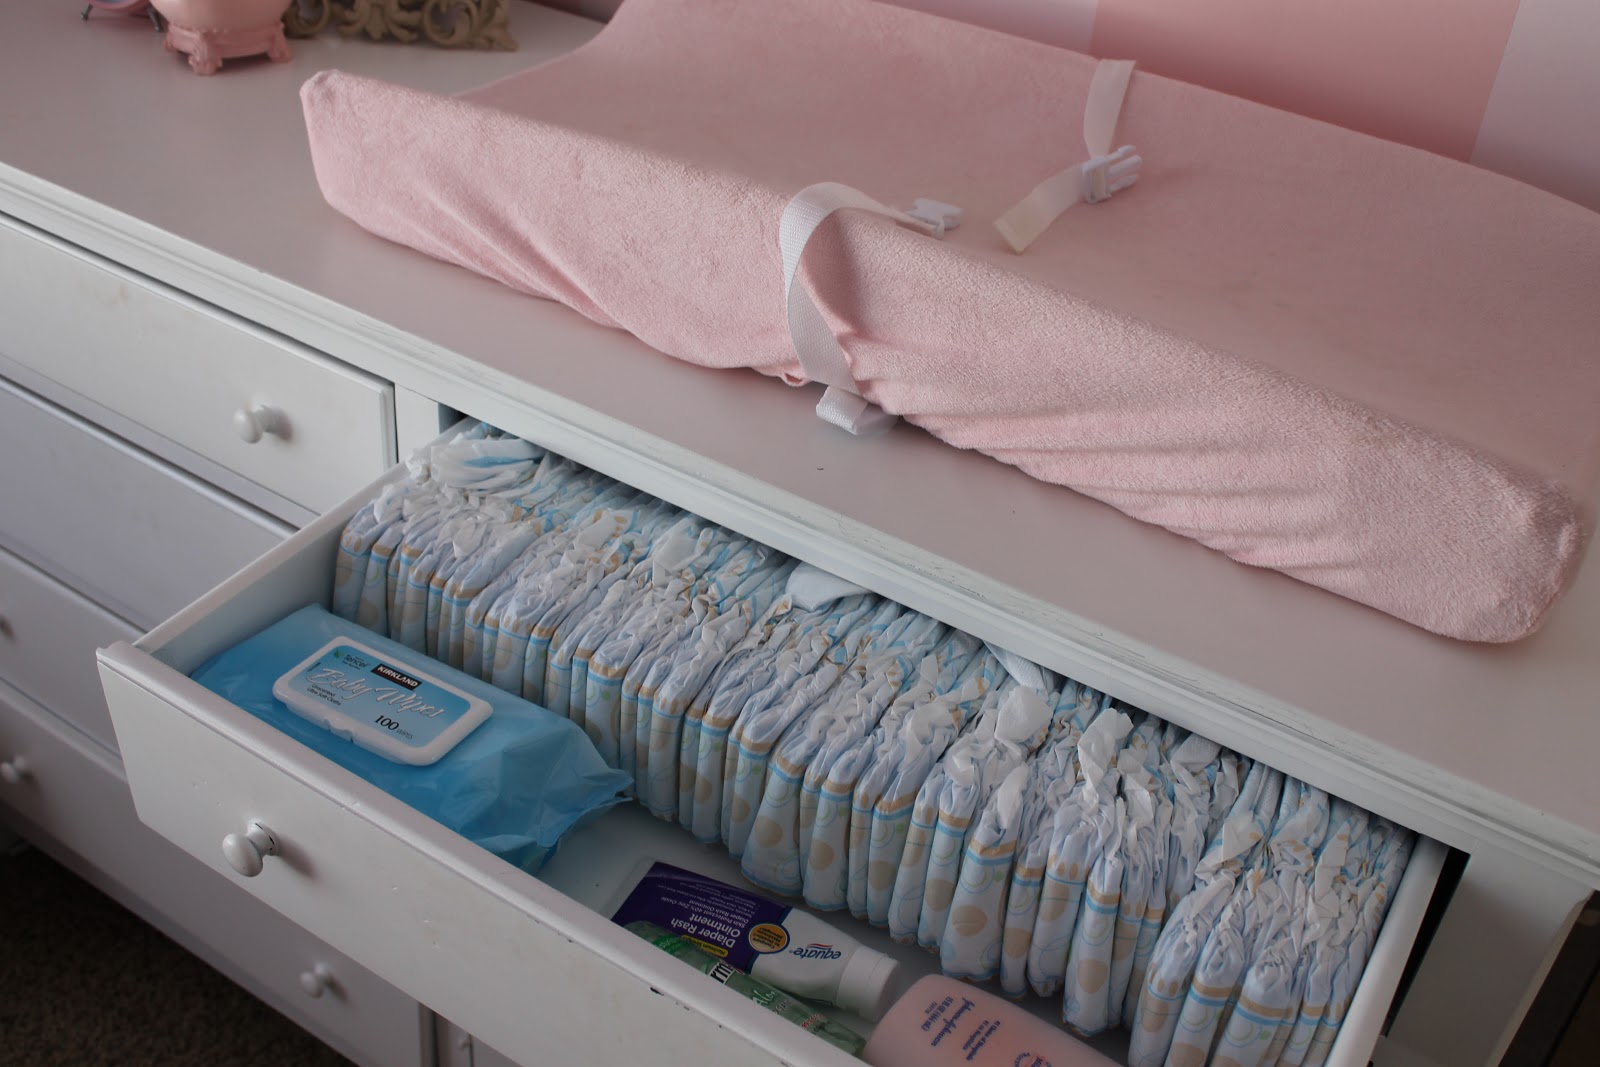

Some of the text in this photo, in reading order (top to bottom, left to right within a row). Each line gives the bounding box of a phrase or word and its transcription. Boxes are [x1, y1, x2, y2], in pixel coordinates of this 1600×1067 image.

[376, 665, 418, 687] KIRKLAND
[306, 666, 444, 719] Baby Wipes
[373, 714, 400, 731] 100
[687, 898, 749, 923] Diaper Rash Ointment
[702, 909, 734, 923] Protectant
[669, 916, 698, 934] Rash
[688, 912, 741, 938] Ointment
[732, 919, 746, 928] Skin
[695, 925, 736, 948] Diaper
[792, 947, 842, 961] equate
